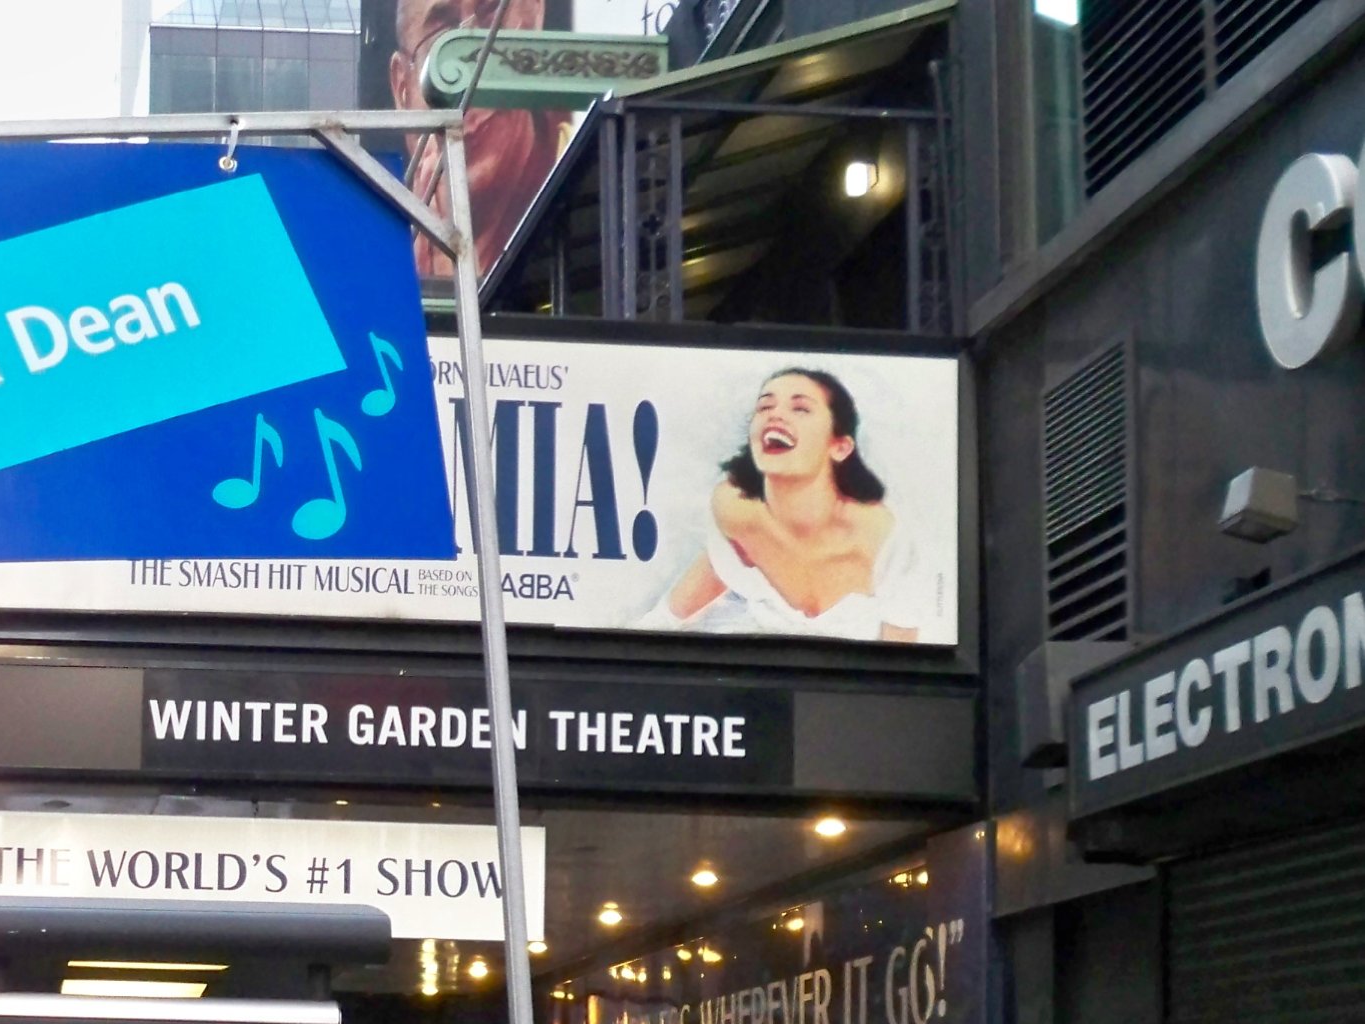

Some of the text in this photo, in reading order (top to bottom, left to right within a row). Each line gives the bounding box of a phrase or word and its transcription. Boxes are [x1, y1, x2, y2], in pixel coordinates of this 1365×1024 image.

[3, 281, 201, 377] Dean
[484, 362, 569, 391] LVAEUS'
[449, 397, 659, 562] MIA!
[129, 559, 415, 595] THE SMASH HIT MUSICAL
[418, 569, 473, 583] BASED ON
[418, 583, 479, 598] THE SONGS
[149, 698, 747, 759] WINTER GARDEN THEATRE
[87, 848, 289, 893] WORLD'S
[306, 857, 352, 895] #1
[376, 858, 503, 899] SHOW
